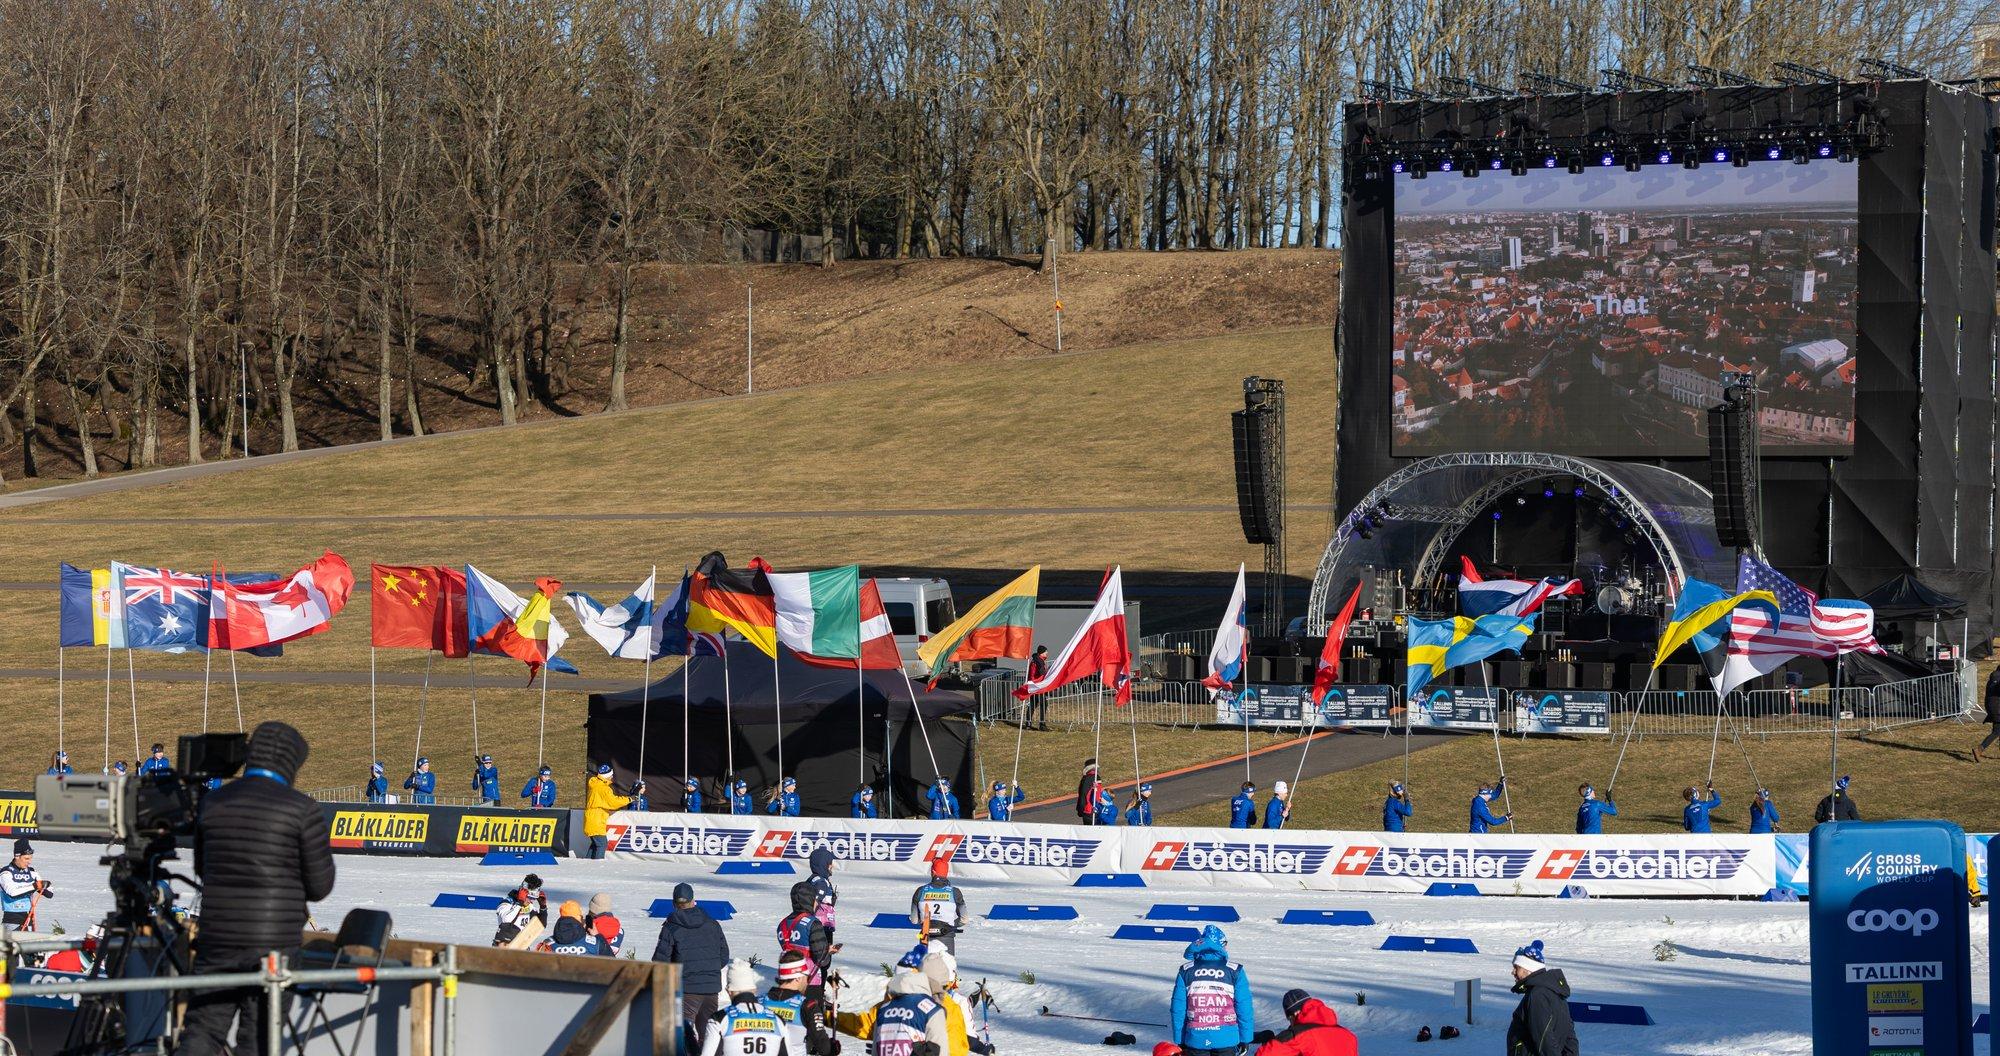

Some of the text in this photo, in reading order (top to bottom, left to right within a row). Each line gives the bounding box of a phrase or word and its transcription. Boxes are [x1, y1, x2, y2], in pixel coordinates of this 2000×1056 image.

[1591, 293, 1649, 315] That
[335, 813, 425, 839] BLÅKLÄDER
[462, 818, 552, 844] BLÅKLÄDER
[630, 824, 732, 855] bächler
[965, 833, 1077, 867] bächler
[1187, 842, 1306, 873] bächler
[1382, 846, 1508, 879] bächler
[1588, 848, 1721, 880] bächler
[1876, 854, 1922, 865] CROSS
[1876, 864, 1938, 876] COUNTRY
[1876, 875, 1935, 884] WORLD CUP
[933, 903, 941, 915] 2
[1846, 908, 1940, 937] coop
[555, 946, 586, 955] coop
[1194, 968, 1225, 979] coop
[1852, 965, 1937, 980] TALLINN
[1191, 996, 1228, 1007] TEAM
[883, 1007, 914, 1021] coop
[1198, 1014, 1220, 1023] NOR
[743, 1037, 767, 1055] 56
